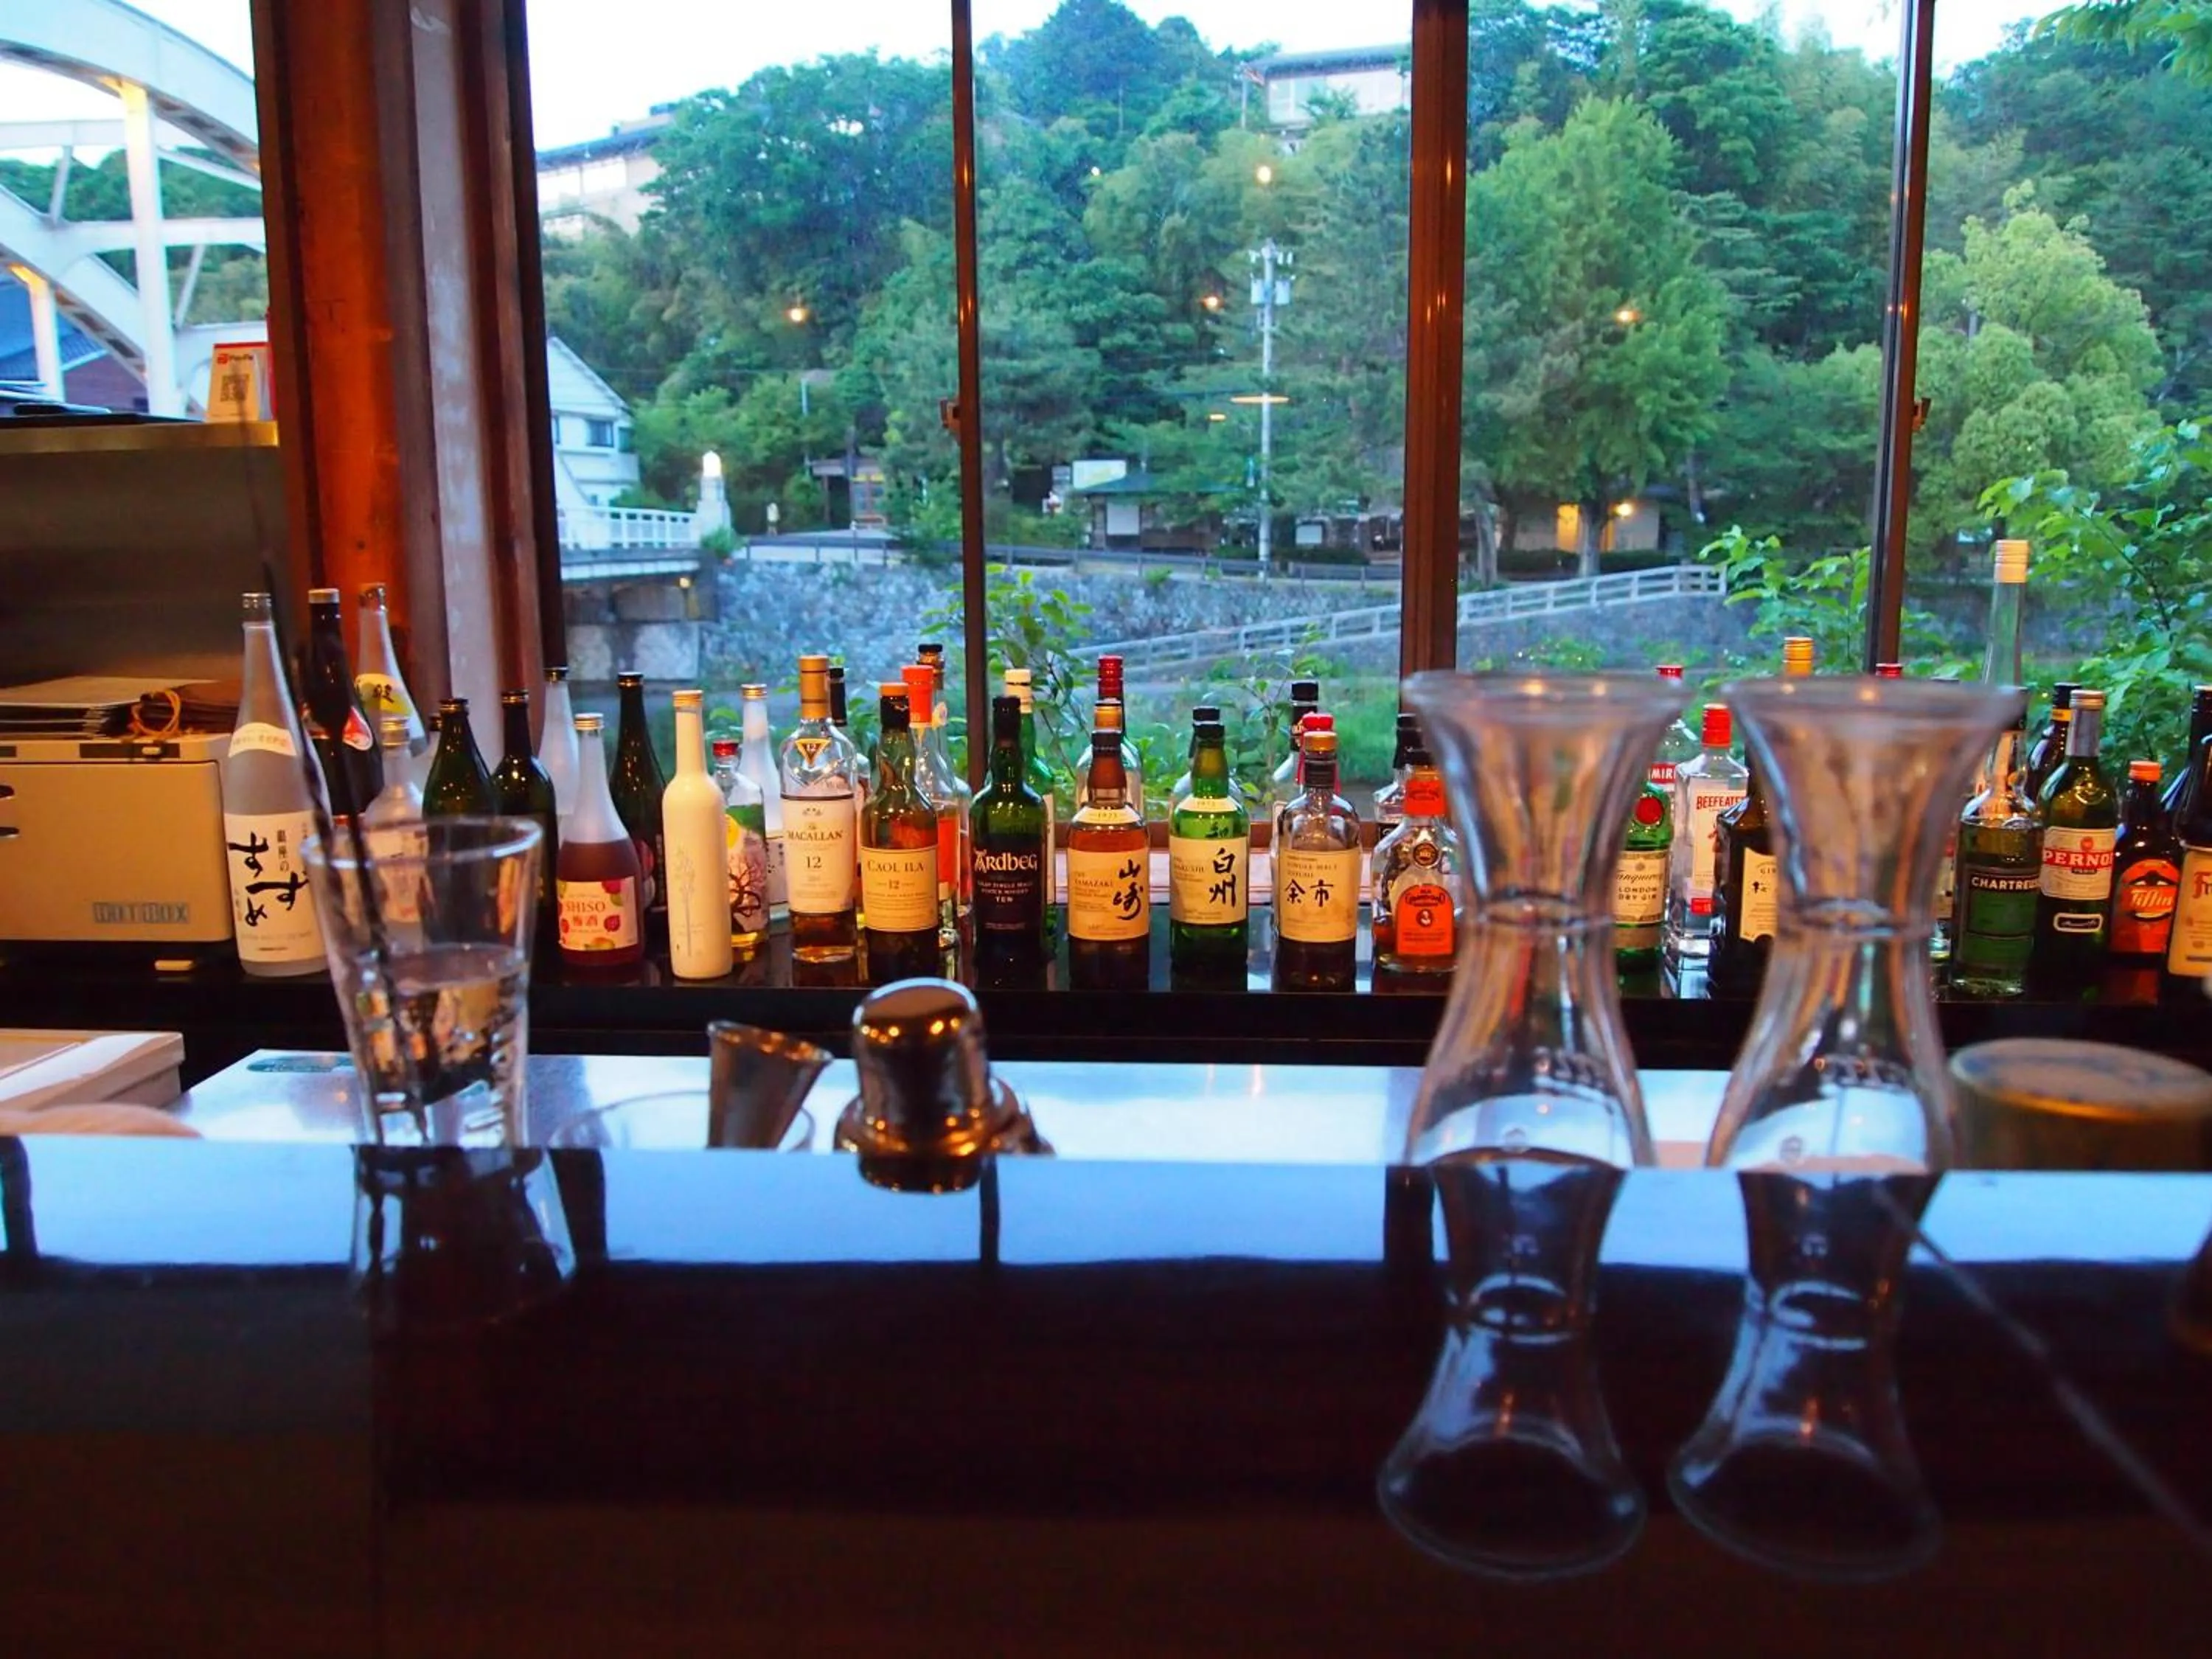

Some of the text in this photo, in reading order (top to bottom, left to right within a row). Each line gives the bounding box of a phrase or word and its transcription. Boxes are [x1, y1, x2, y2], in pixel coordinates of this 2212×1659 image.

[1649, 767, 1676, 780] MIR
[787, 829, 843, 843] MACALLAN
[806, 856, 822, 869] 12
[867, 860, 925, 872] CAOL ILA
[1209, 848, 1237, 908] 白州
[1112, 858, 1144, 921] 山崎
[1284, 878, 1335, 908] 余市
[2131, 888, 2173, 908] Tiffin
[566, 900, 606, 913] SHISO
